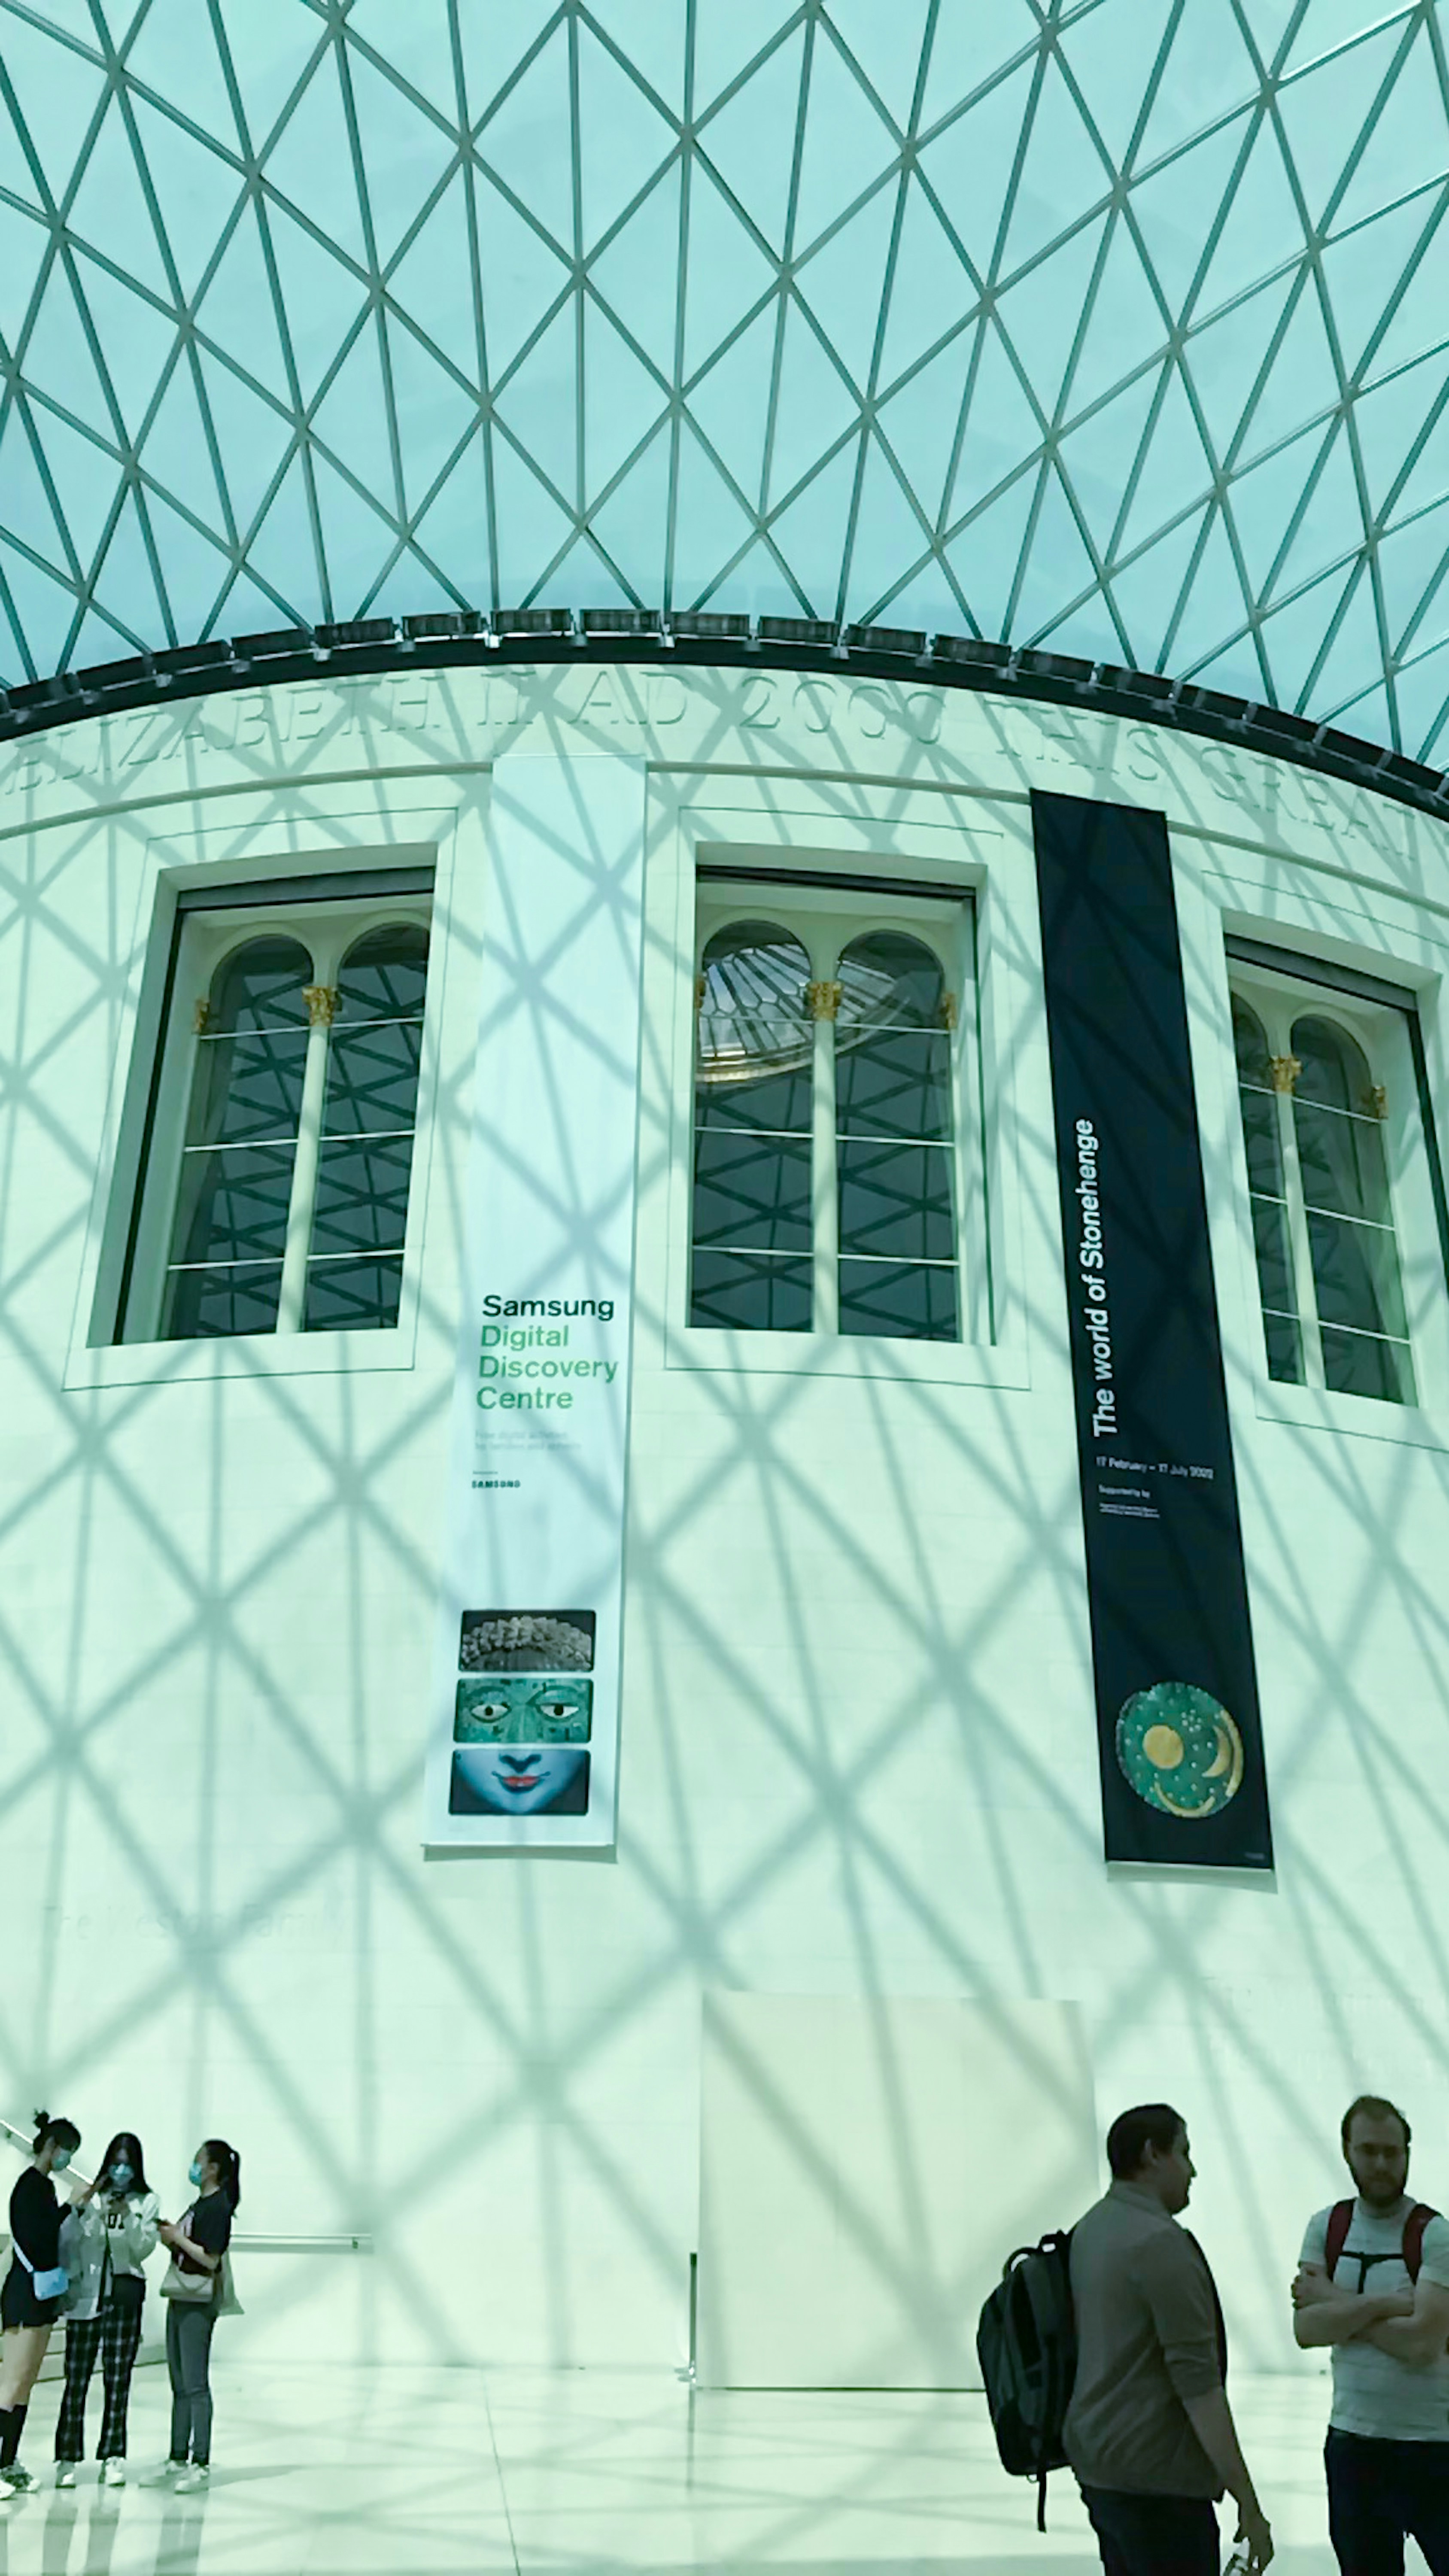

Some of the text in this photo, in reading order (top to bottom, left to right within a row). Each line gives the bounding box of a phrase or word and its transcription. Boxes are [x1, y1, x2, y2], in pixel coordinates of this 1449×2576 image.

[5, 675, 444, 795] ELIZABETH
[567, 671, 688, 725] AD
[739, 676, 946, 744] 2000
[1075, 1119, 1117, 1437] The world of Stonehenge
[482, 1295, 614, 1321] Samsung
[480, 1325, 569, 1351] Digital
[479, 1355, 618, 1383] Discovery
[476, 1386, 573, 1409] Centre
[471, 1480, 520, 1488] SAMSUNG
